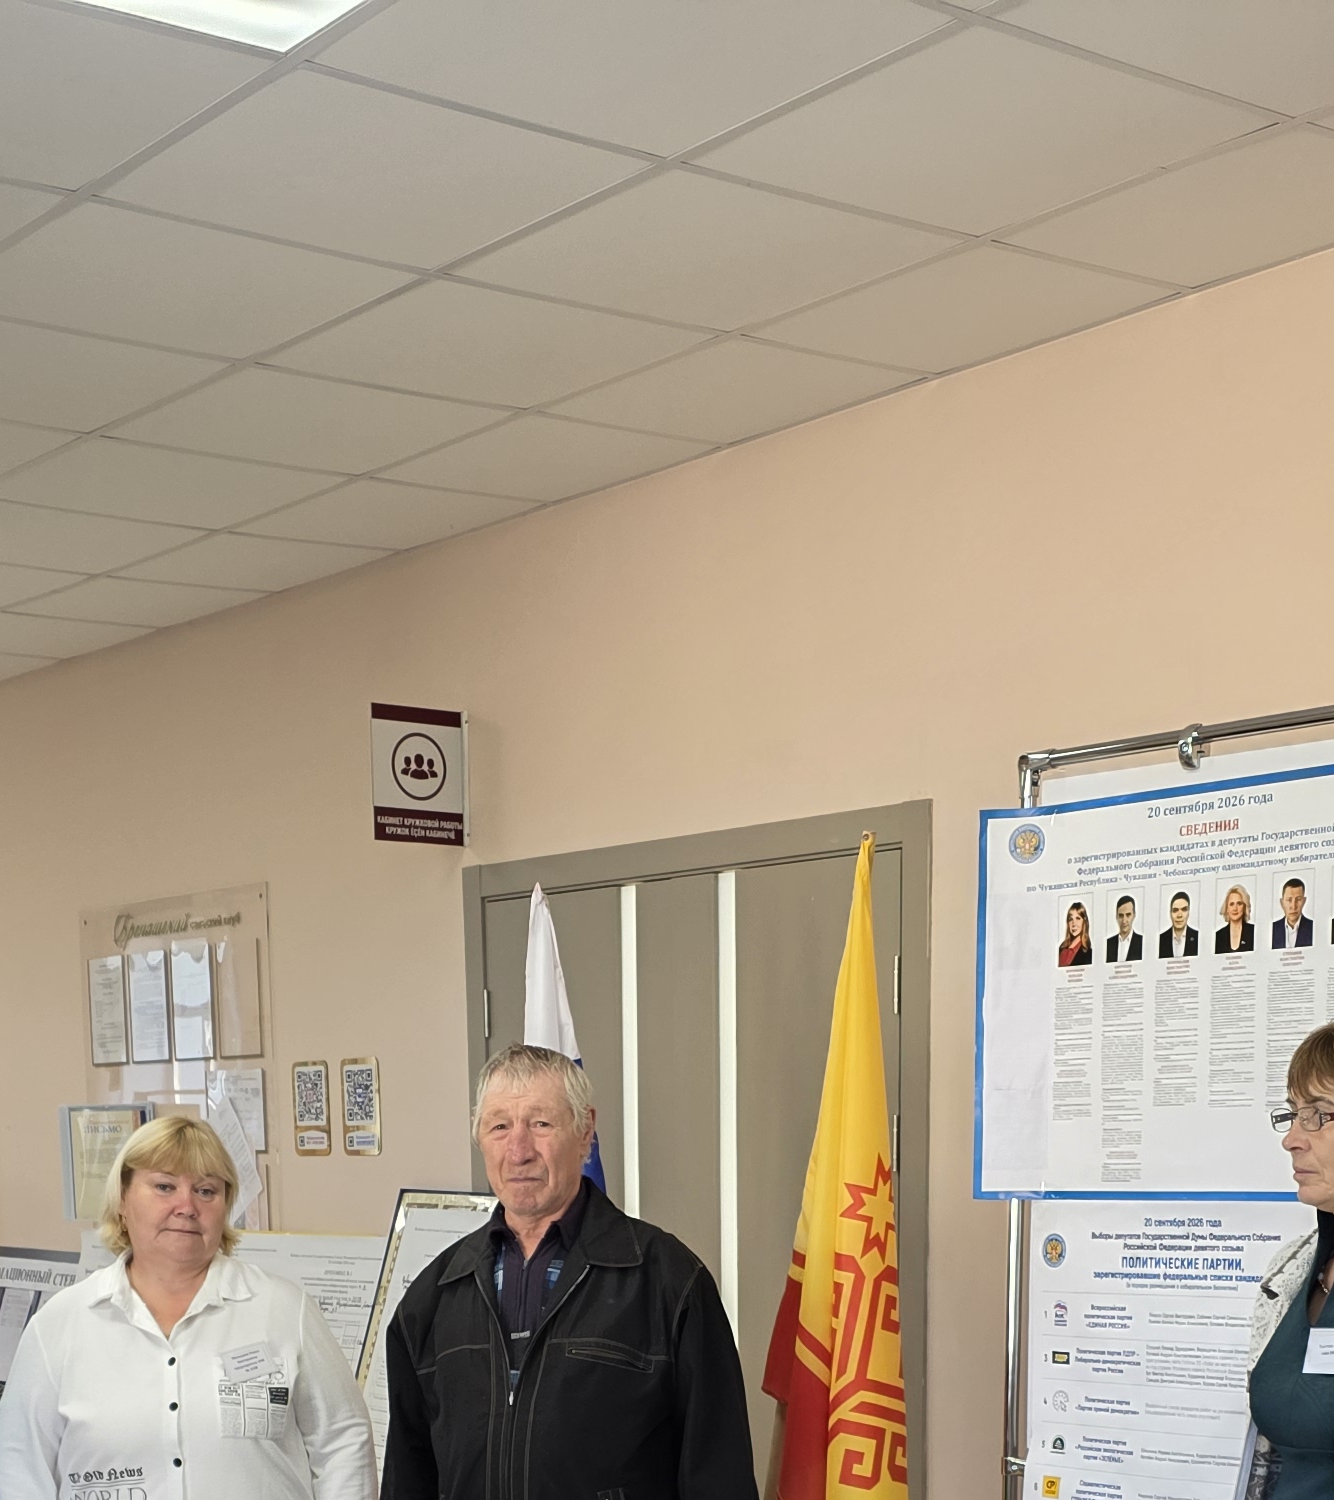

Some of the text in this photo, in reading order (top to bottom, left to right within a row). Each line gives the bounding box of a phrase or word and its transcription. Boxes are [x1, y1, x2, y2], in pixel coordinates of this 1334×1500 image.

[1147, 792, 1273, 818] 20 сентября 2026 года
[377, 816, 403, 824] КАБИНЕТ
[1179, 818, 1240, 836] СВЕДЕНИЯ
[1067, 856, 1073, 864] о
[1073, 847, 1158, 865] зарегистрированных
[1159, 840, 1209, 854] кандидатах
[1211, 840, 1216, 848] в
[1217, 832, 1259, 848] депутаты
[1077, 861, 1132, 876] Федерального
[1134, 856, 1174, 872] Собрания
[1176, 848, 1225, 866] Российской
[1227, 846, 1277, 860] Федерации
[1278, 840, 1319, 854] девятого
[1039, 880, 1077, 891] Чувашская
[1079, 876, 1117, 888] Республика
[1123, 872, 1157, 882] Чувашия
[1163, 864, 1221, 878] Чебоксарскому
[1221, 856, 1289, 873] одномандатному
[1144, 1218, 1222, 1228] 20 сентября 2026 года
[1121, 1256, 1245, 1273] ПОЛИТИЧЕСКИЕ ПАРТИИ,
[53, 1272, 77, 1287] СТЕН
[83, 1467, 143, 1482] Old News
